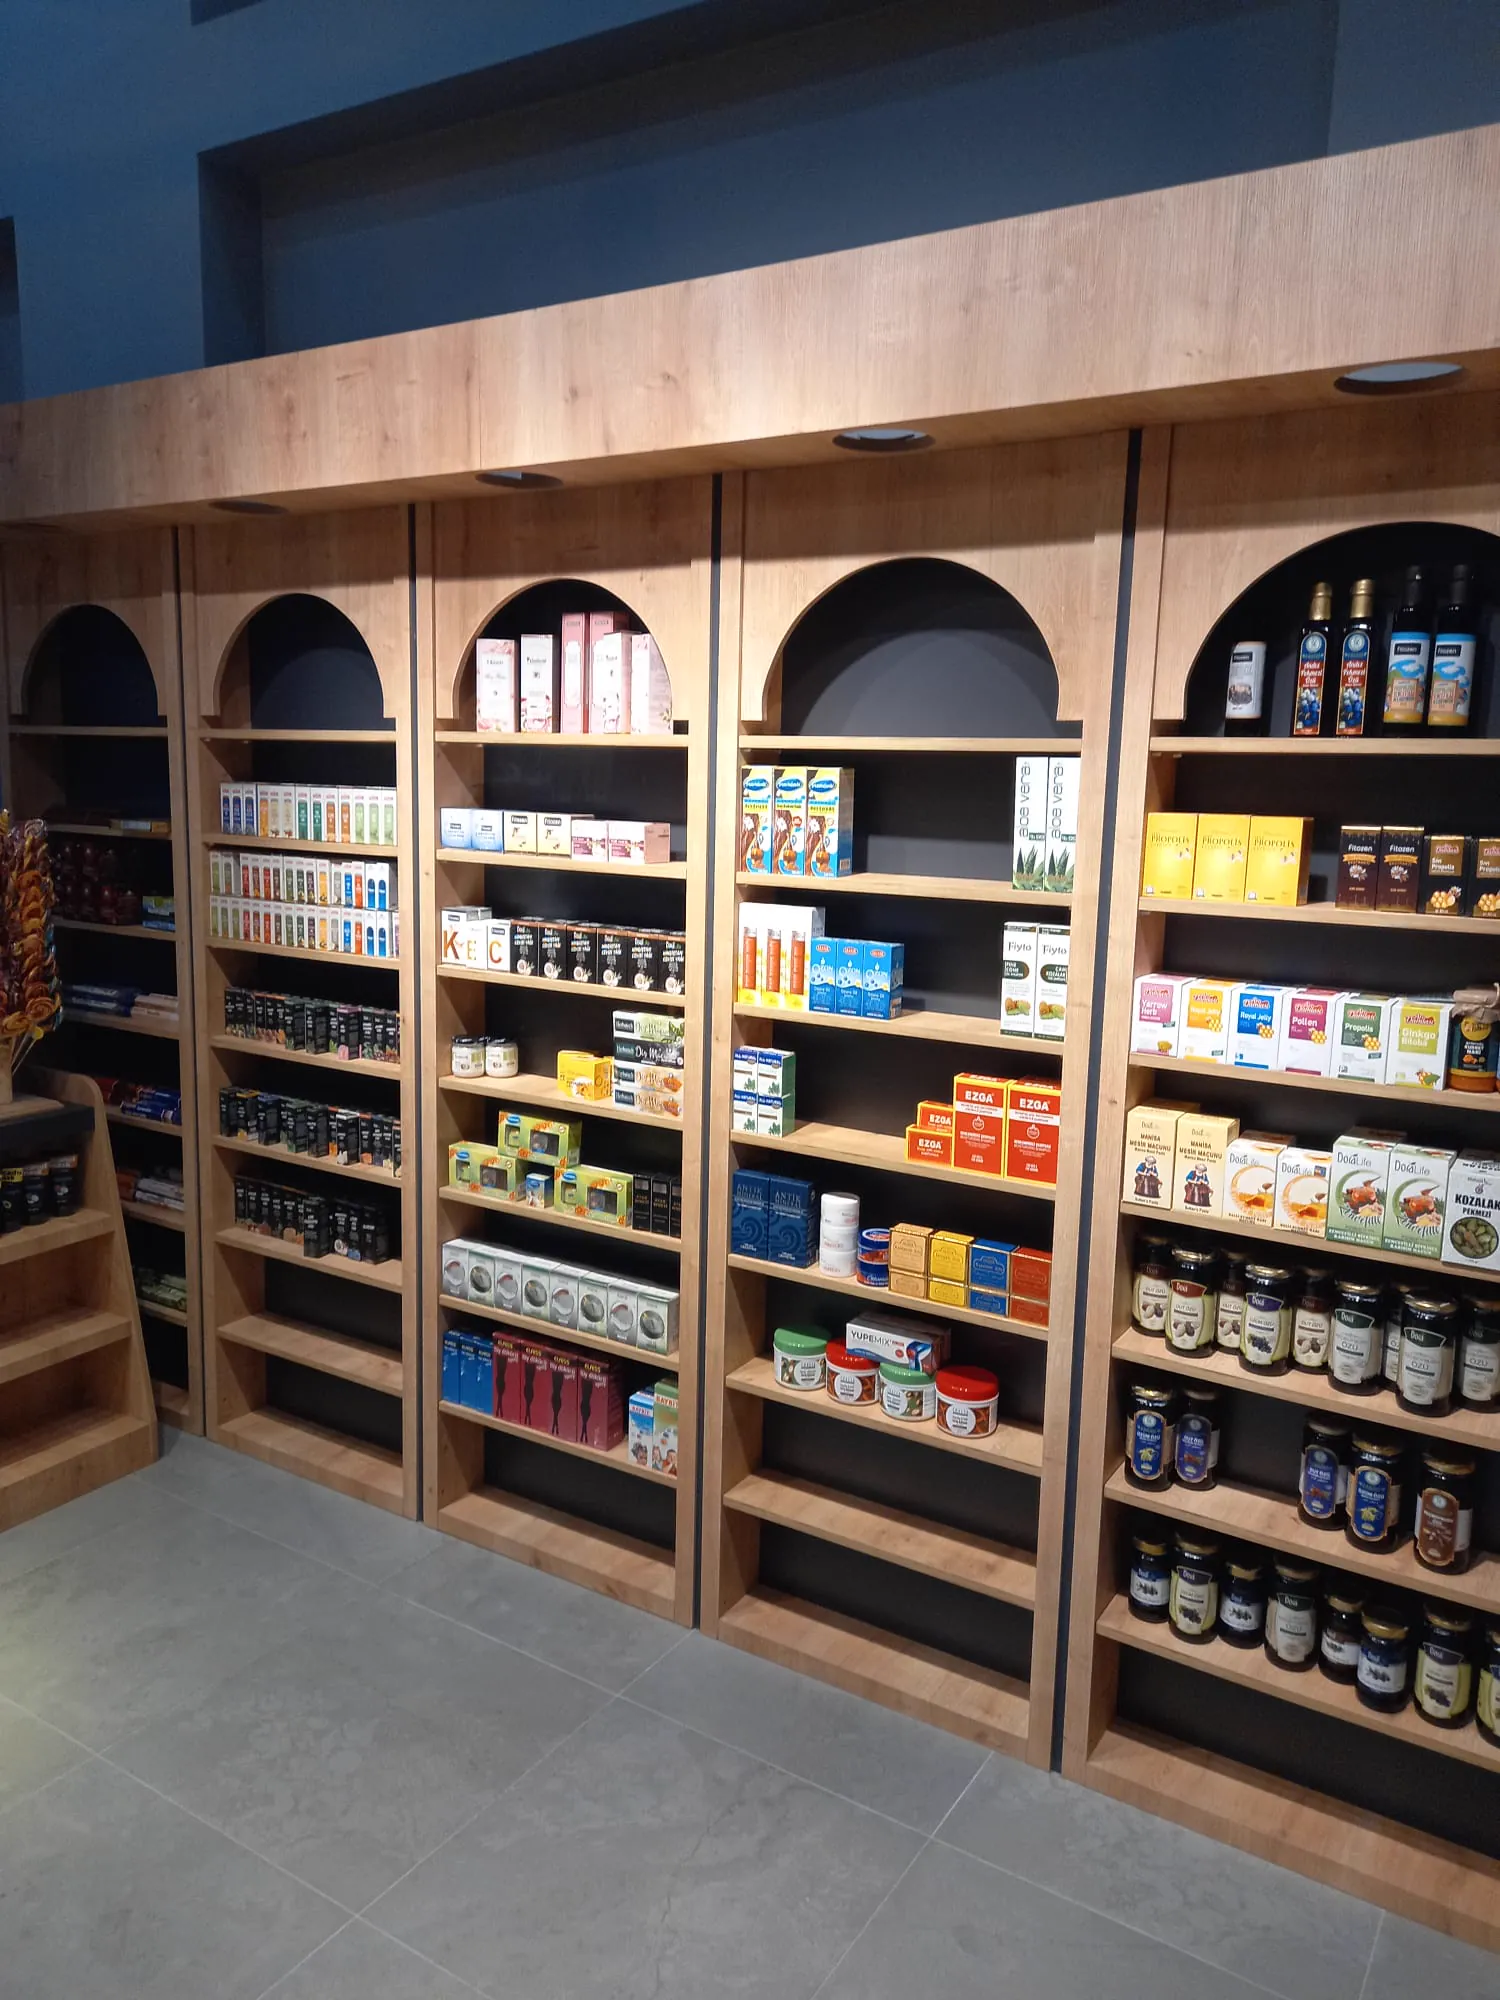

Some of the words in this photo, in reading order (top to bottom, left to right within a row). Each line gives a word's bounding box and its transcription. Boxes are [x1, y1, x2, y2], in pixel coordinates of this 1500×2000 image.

[1348, 844, 1373, 852] Fitozen
[1389, 844, 1415, 853] Fitozen
[443, 930, 460, 960] K
[489, 941, 502, 964] C
[1142, 1000, 1168, 1009] Yarrow
[1240, 1011, 1257, 1021] Royal
[1257, 1013, 1272, 1023] Jelly
[1292, 1017, 1318, 1027] Pollen
[1345, 1022, 1374, 1033] Propolis
[1403, 1028, 1436, 1040] Ginkgo
[965, 1090, 994, 1104] EZGA
[1019, 1098, 1049, 1112] EZGA
[930, 1114, 952, 1125] EZGA
[918, 1138, 942, 1149] EZGA
[1455, 1193, 1500, 1211] KOZALAK
